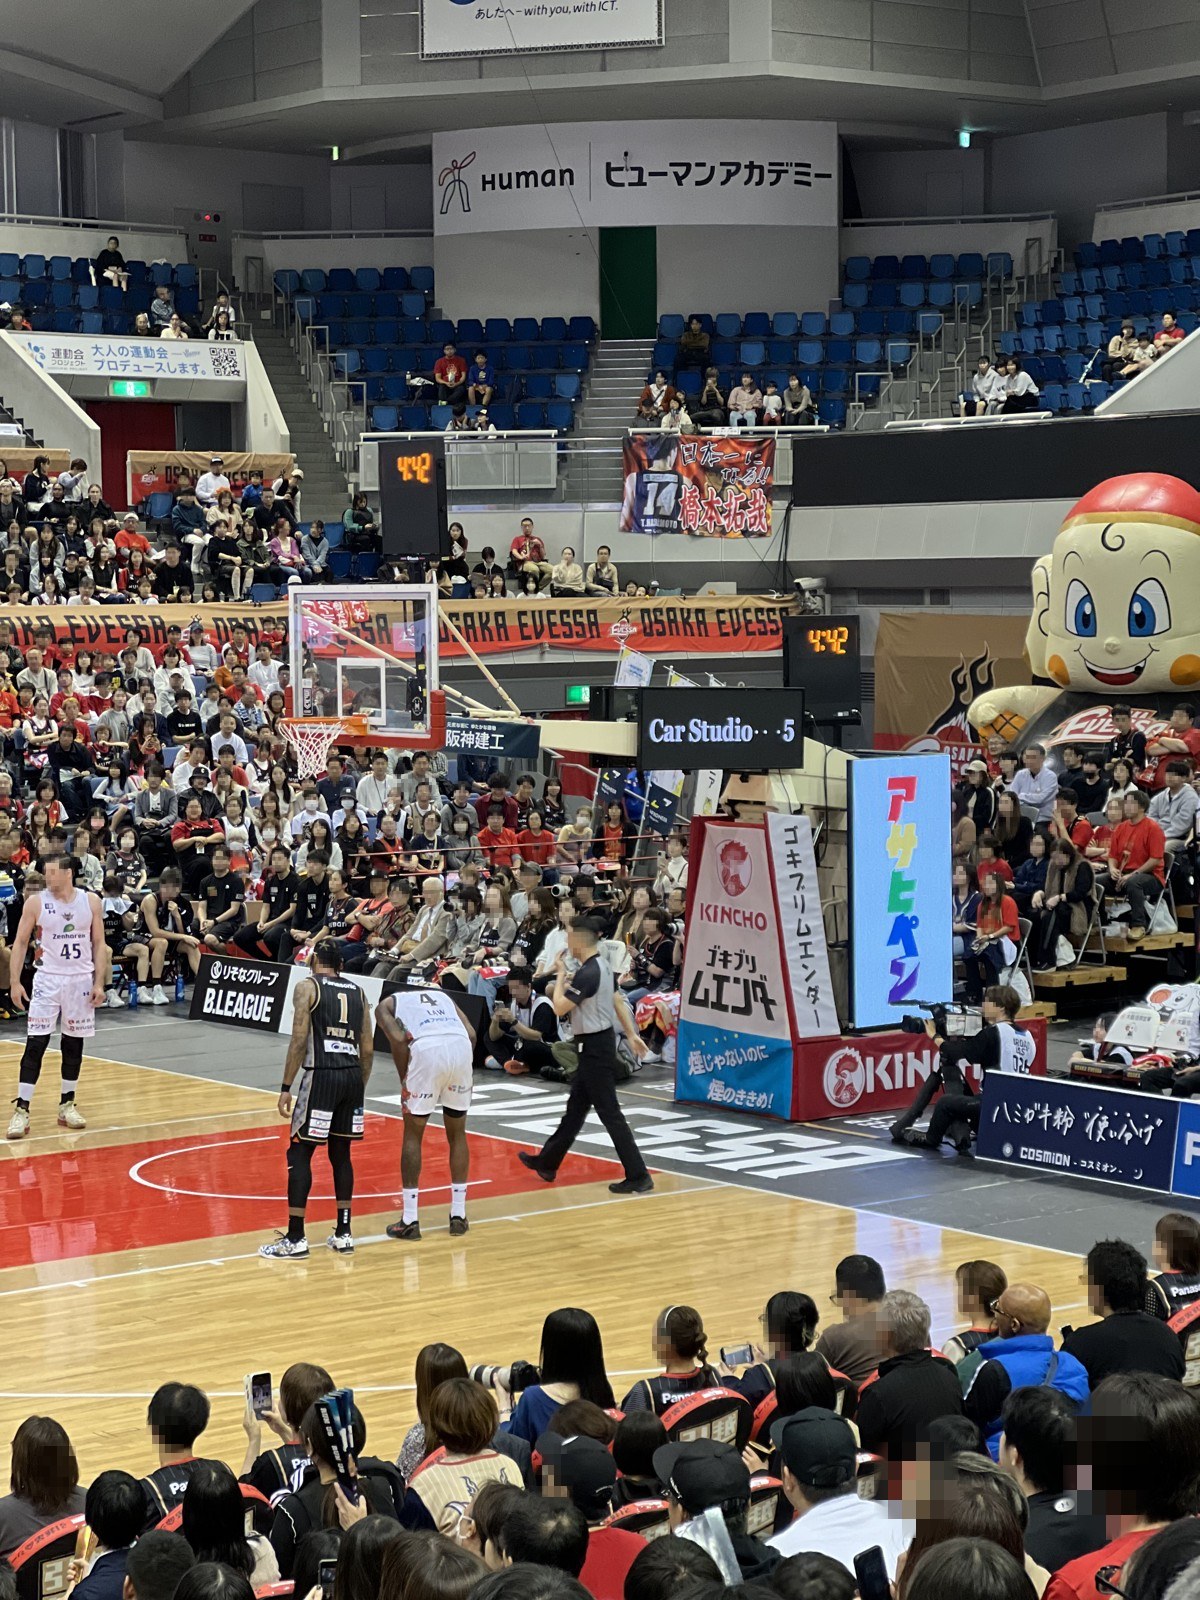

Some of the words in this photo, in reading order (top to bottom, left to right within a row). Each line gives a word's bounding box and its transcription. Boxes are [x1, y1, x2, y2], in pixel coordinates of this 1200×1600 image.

[524, 4, 548, 16] with
[549, 6, 572, 18] you,
[572, 2, 596, 14] with
[480, 166, 575, 192] Human
[604, 160, 833, 188] ヒューマンアカデミー
[51, 348, 84, 360] 運動会
[91, 344, 168, 360] 大人の運動会
[94, 359, 207, 376] プロデュースします。
[397, 452, 431, 484] 4:42
[680, 441, 764, 468] 日本一に
[678, 485, 768, 534] 橋本拓哉
[518, 609, 602, 640] EVESSA
[640, 608, 709, 638] OSAKA
[807, 626, 849, 654] 4:42
[445, 729, 505, 750] 阪神建工
[649, 717, 686, 743] Car
[886, 776, 921, 1004] アサヒペン
[700, 902, 768, 932] KINCHO
[784, 825, 820, 1029] ゴキブリムエンダー
[60, 942, 82, 960] 45
[706, 944, 757, 974] ゴキブリ
[223, 964, 280, 986] りそなグループ
[202, 987, 275, 1023] B.LEAGUE
[337, 992, 348, 1024] 1
[420, 993, 438, 1006] 4
[688, 970, 778, 1022] ムエンダ
[688, 1044, 770, 1076] 煙じゃないのに
[706, 1078, 774, 1110] 煙のききめ!
[992, 1102, 1076, 1136] ハミガキ粉
